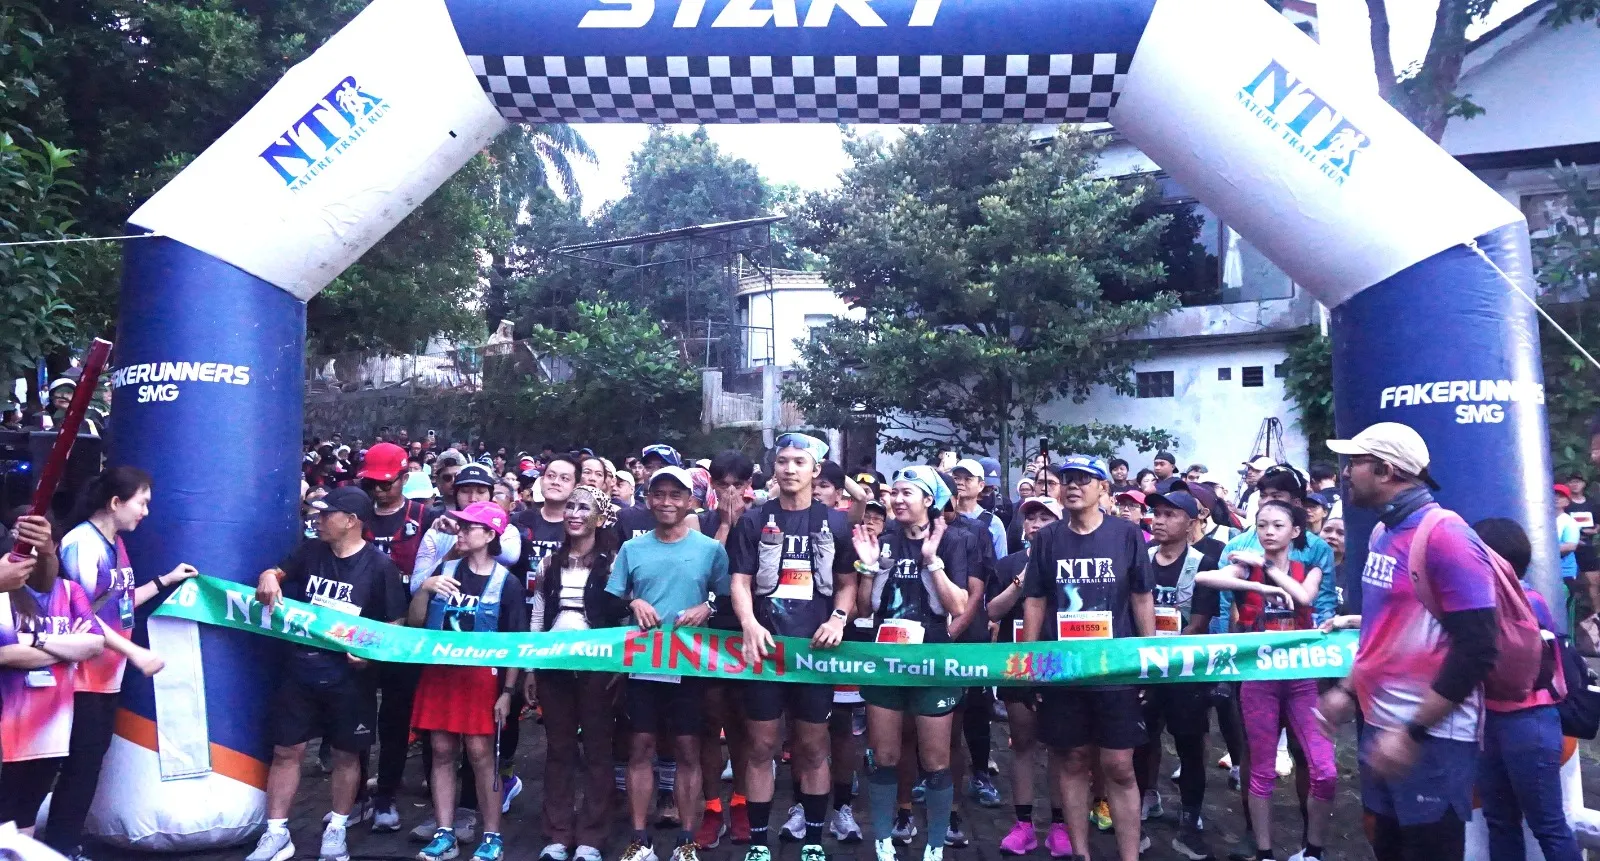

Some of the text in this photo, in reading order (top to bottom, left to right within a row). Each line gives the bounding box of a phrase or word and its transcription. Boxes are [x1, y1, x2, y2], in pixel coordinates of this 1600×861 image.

[258, 75, 382, 186] NTR
[1234, 91, 1346, 187] NATURE TRAIL RUN
[1242, 58, 1371, 176] NTR
[290, 102, 392, 194] NATURE TRAIL RUN
[137, 384, 179, 403] SMG
[1455, 404, 1504, 424] SMG
[305, 575, 354, 602] NTR
[1056, 558, 1116, 578] NTR
[432, 642, 508, 660] Nature
[570, 642, 613, 658] Run
[623, 630, 785, 676] FINISH
[796, 652, 876, 674] Nature
[884, 658, 935, 677] Trail
[944, 659, 989, 678] Run
[1137, 643, 1241, 679] NTR
[1256, 644, 1344, 671] Series
